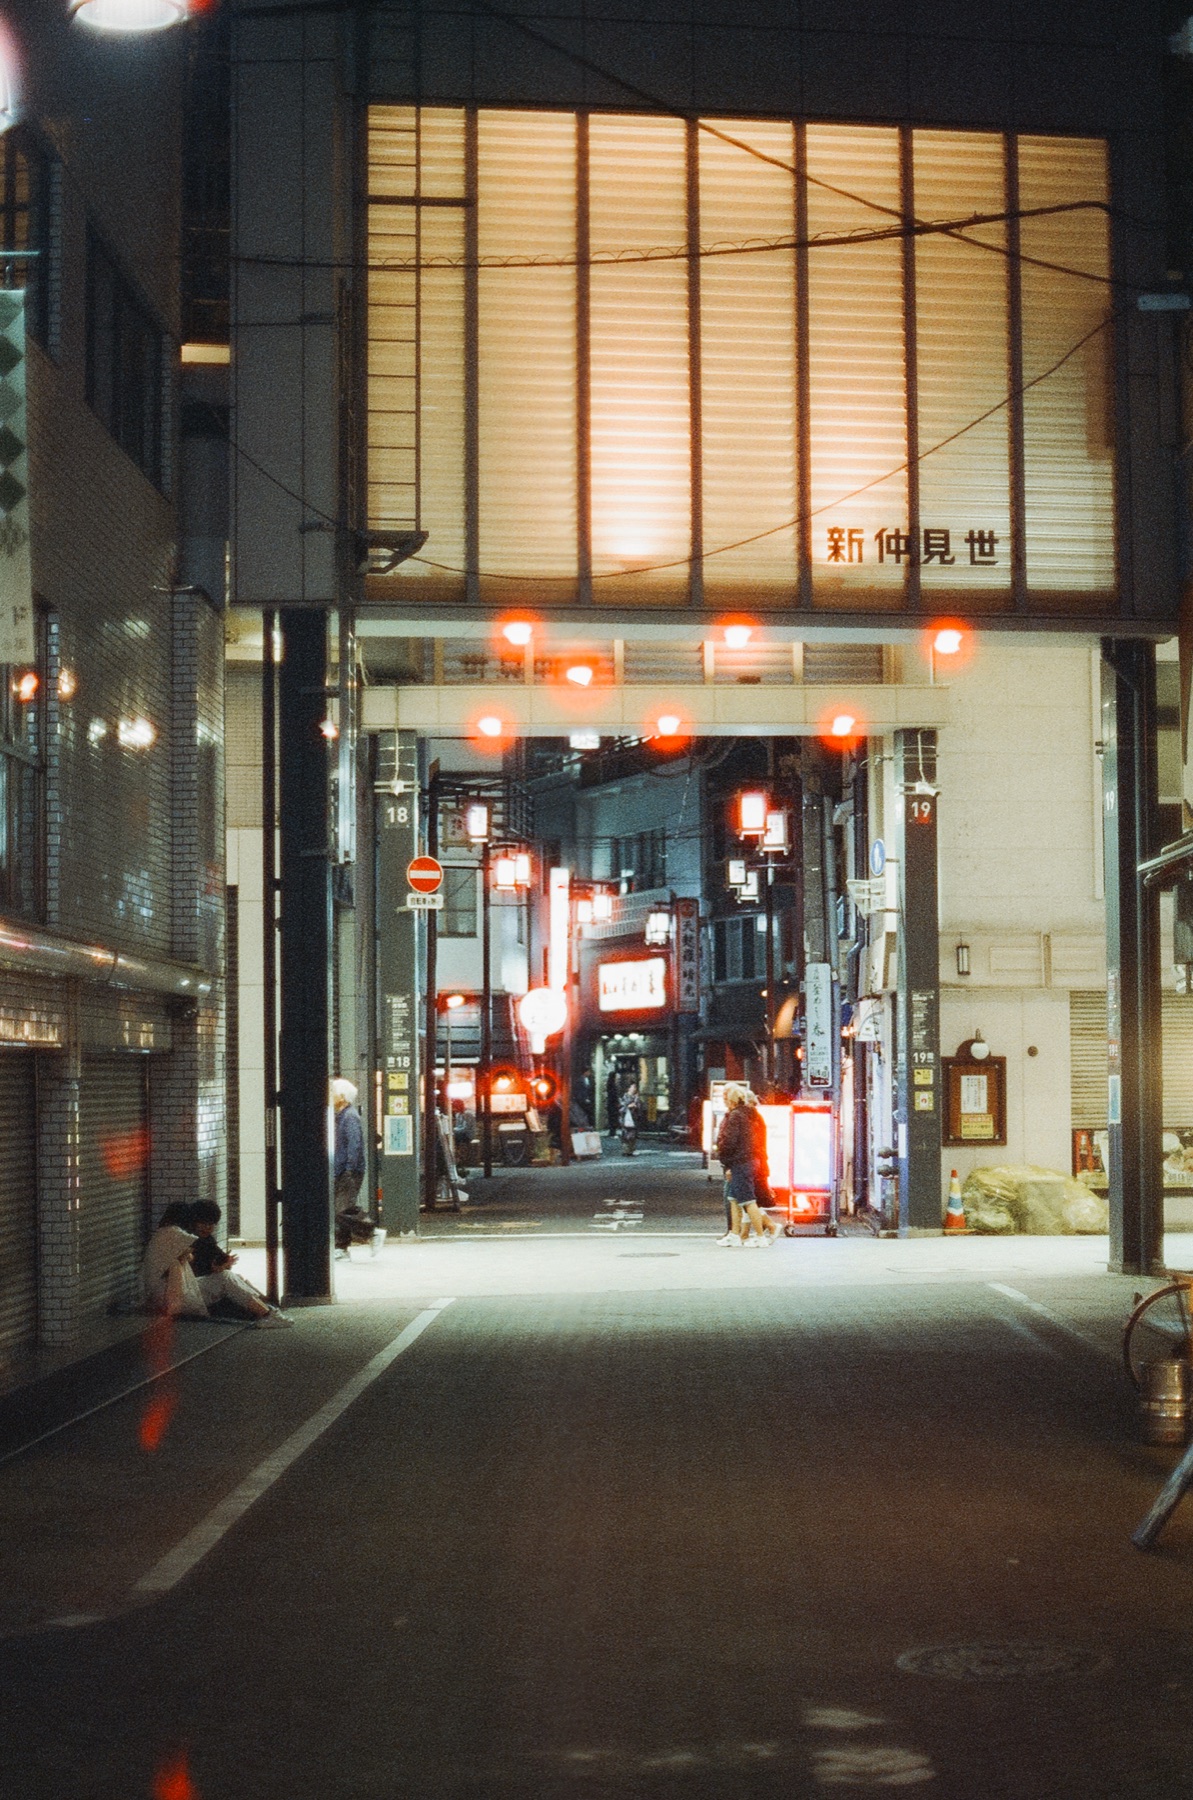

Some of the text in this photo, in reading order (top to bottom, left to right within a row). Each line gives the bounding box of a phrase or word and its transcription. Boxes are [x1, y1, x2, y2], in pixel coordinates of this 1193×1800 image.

[827, 526, 999, 566] 新仲見世
[387, 806, 408, 823] 18
[911, 801, 931, 818] 19
